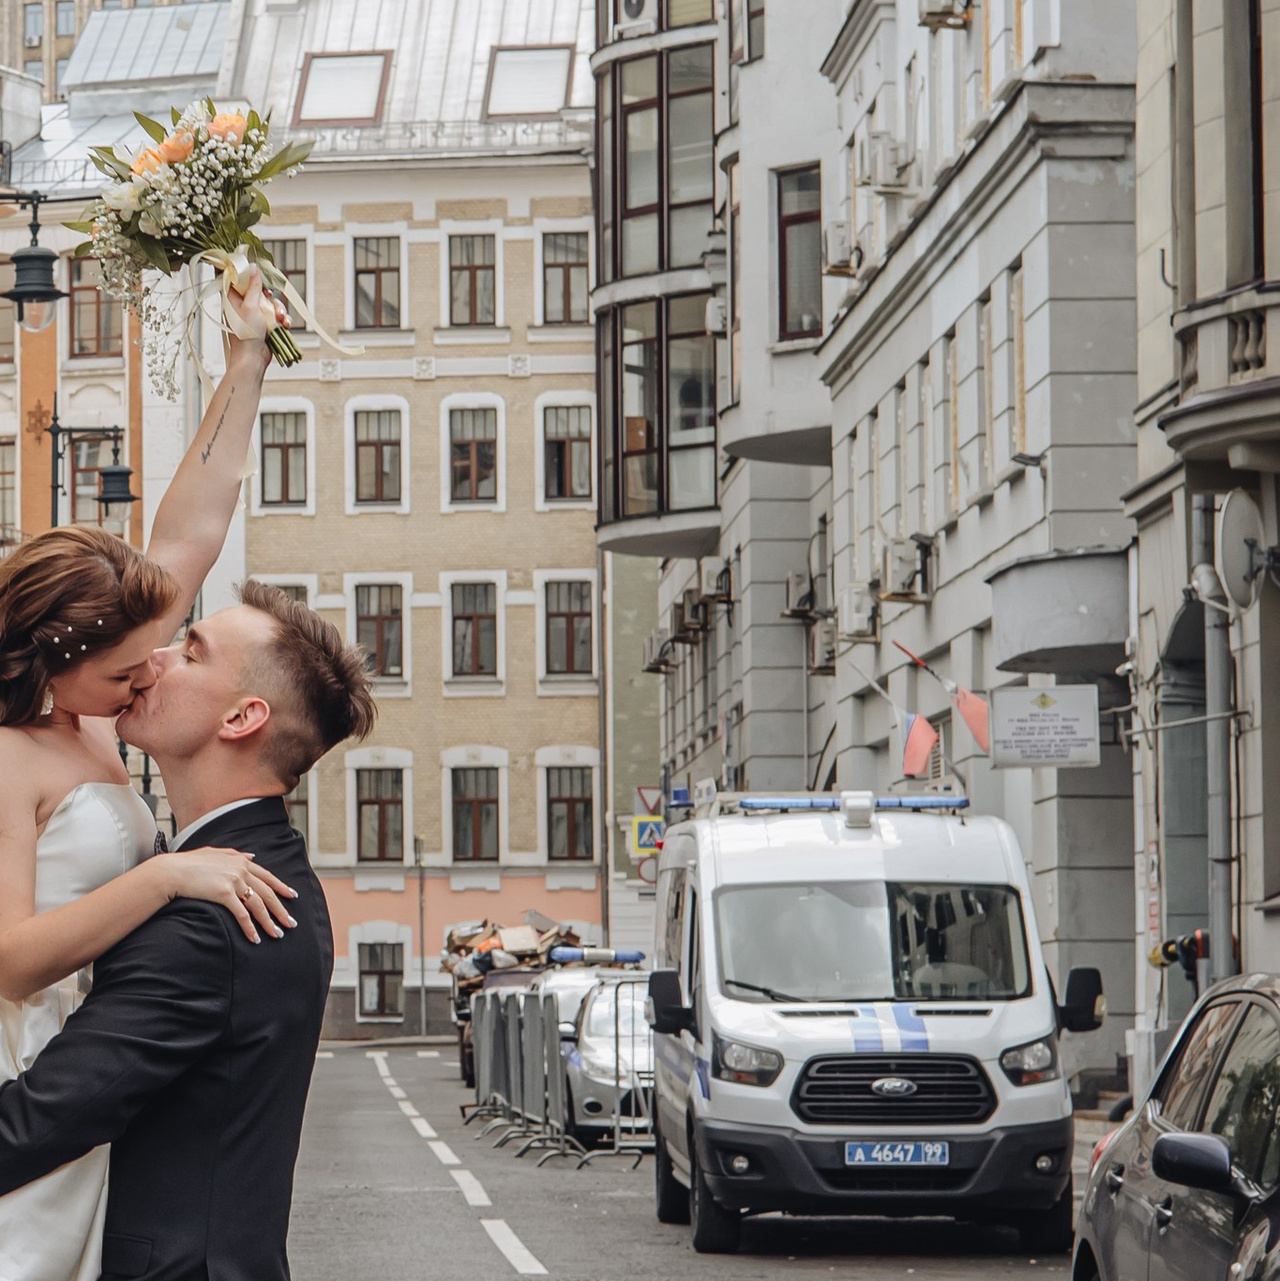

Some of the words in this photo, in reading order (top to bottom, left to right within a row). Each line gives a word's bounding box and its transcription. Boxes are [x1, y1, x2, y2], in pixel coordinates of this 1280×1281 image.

[854, 1147, 866, 1162] А
[871, 1144, 915, 1162] 4647
[924, 1143, 942, 1158] 99
